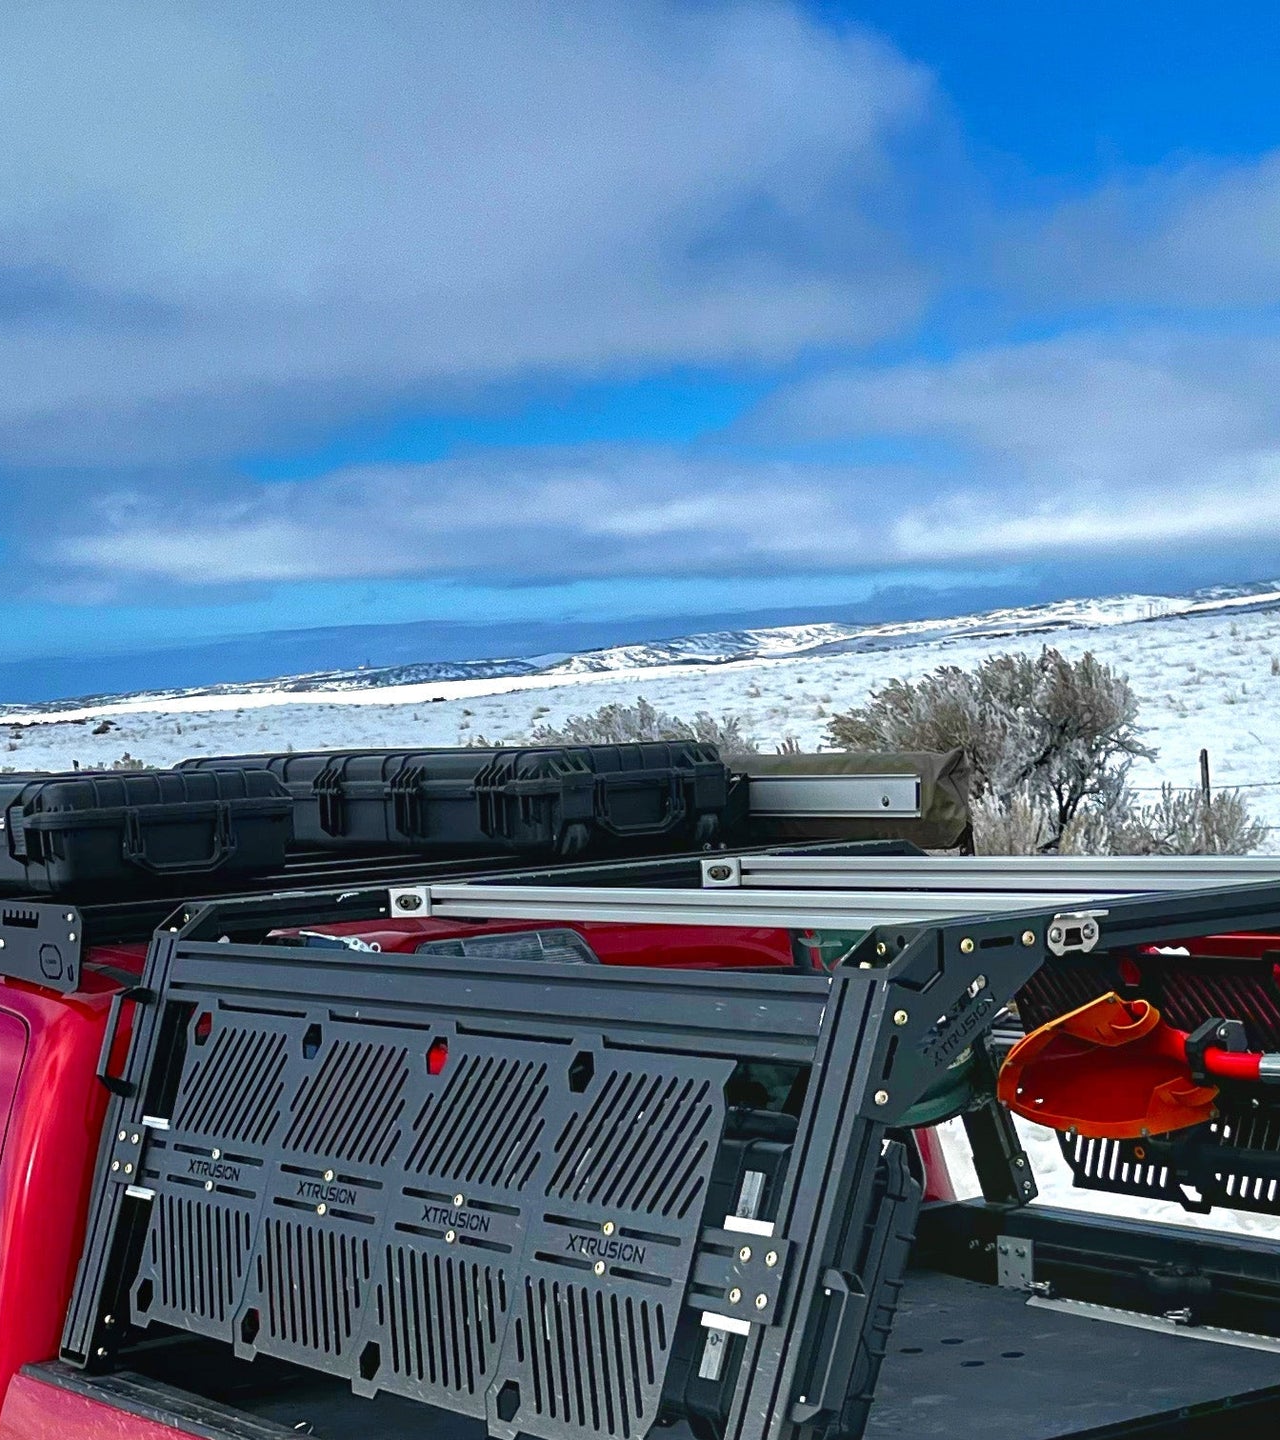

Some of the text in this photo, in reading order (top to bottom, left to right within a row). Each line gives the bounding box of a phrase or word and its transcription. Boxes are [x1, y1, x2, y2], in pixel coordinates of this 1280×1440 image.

[188, 1159, 241, 1182] XTRUSION
[296, 1181, 357, 1205] XTRUSION
[421, 1205, 490, 1232] XTRUSION
[566, 1233, 646, 1264] XTRUSION
